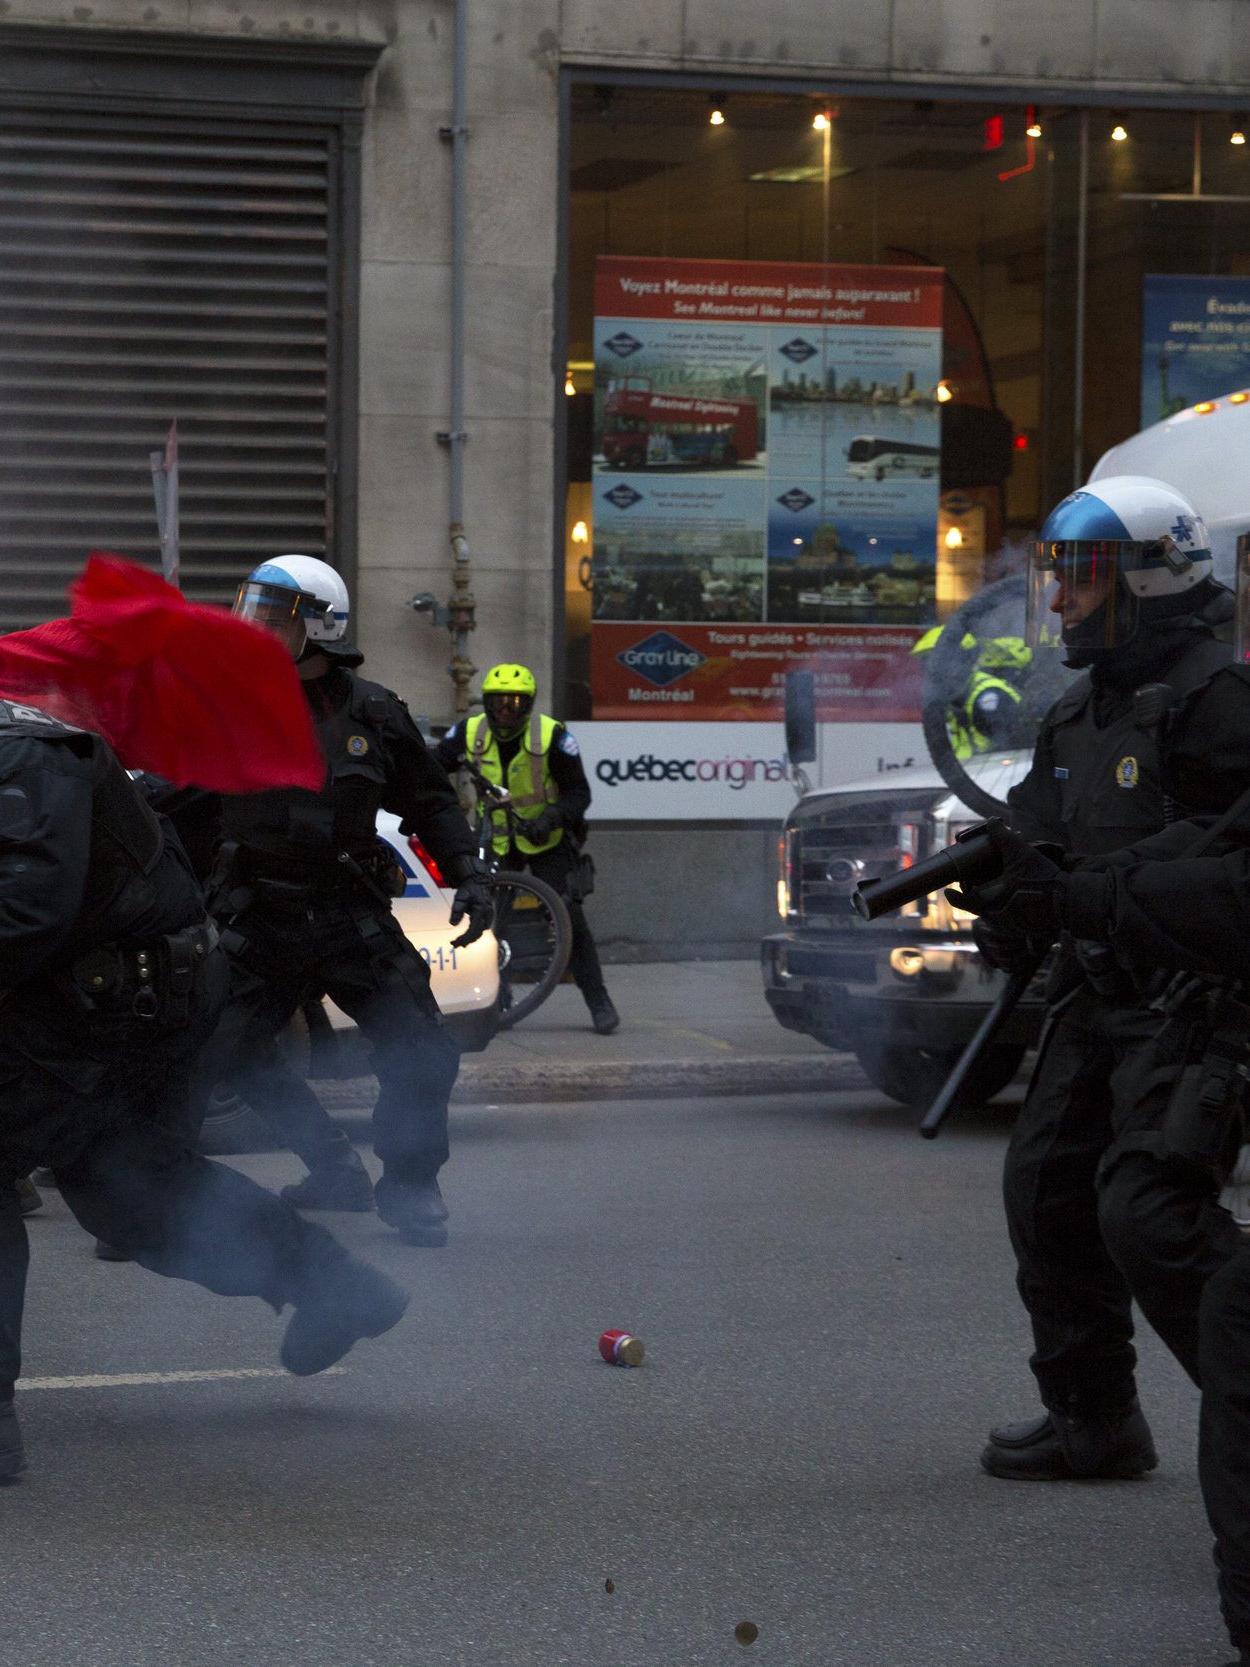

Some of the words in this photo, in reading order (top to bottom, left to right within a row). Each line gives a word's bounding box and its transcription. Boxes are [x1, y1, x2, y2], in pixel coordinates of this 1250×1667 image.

[619, 278, 660, 297] Voyez
[664, 279, 729, 296] Montréal
[731, 284, 785, 298] comme
[787, 284, 833, 302] jamais
[835, 289, 911, 305] auparavant
[674, 300, 695, 315] See
[699, 302, 758, 317] Montreal
[760, 304, 782, 317] like
[784, 307, 819, 319] never
[707, 631, 746, 645] Tours
[748, 632, 793, 647] guidés
[805, 632, 864, 646] Services
[628, 688, 695, 701] Montréal
